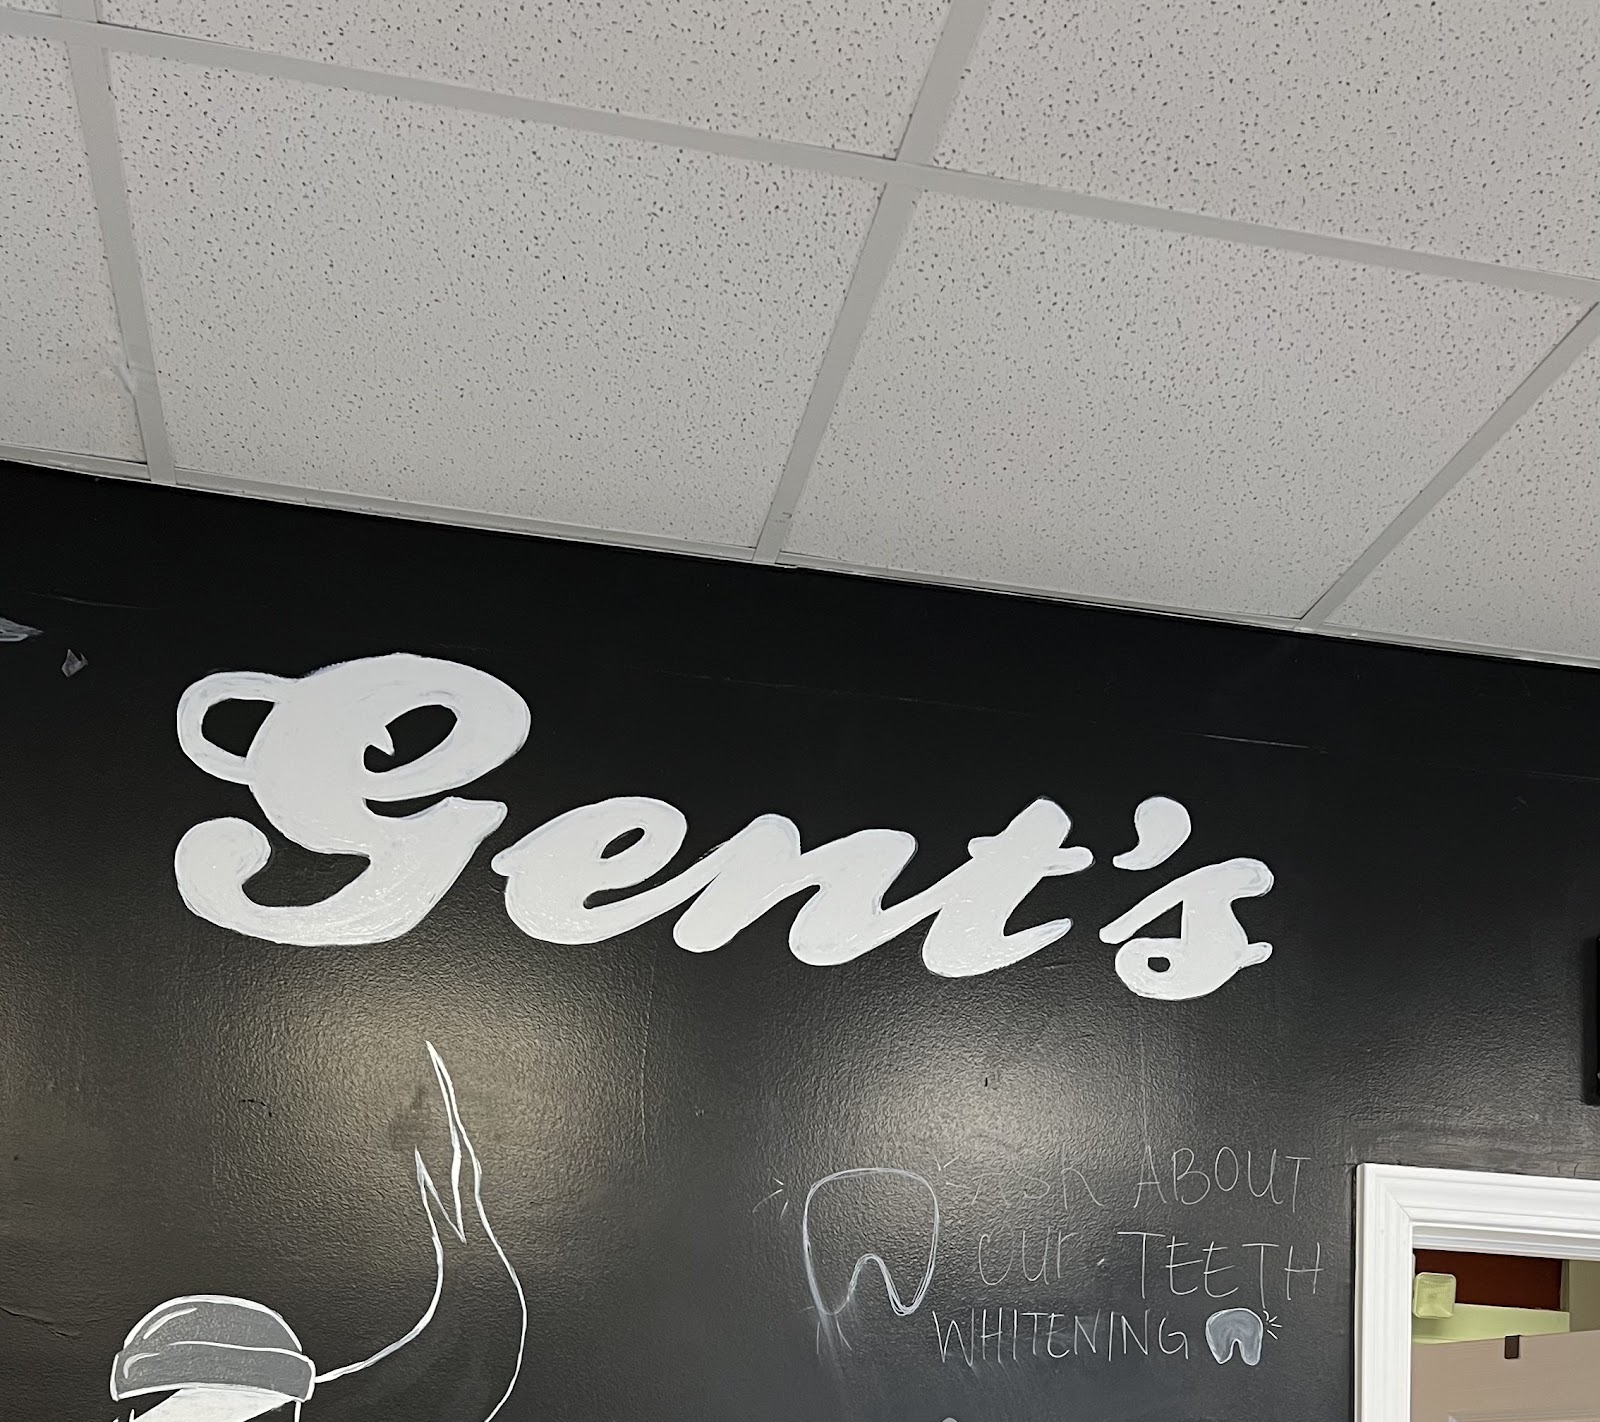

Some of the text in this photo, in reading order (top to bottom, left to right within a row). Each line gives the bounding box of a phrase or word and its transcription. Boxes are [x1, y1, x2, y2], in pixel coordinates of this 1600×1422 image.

[175, 653, 1273, 1000] Gent's
[1134, 1146, 1310, 1213] ABOUT
[1117, 1232, 1324, 1300] TEETH
[932, 1309, 1189, 1367] WHITENING
